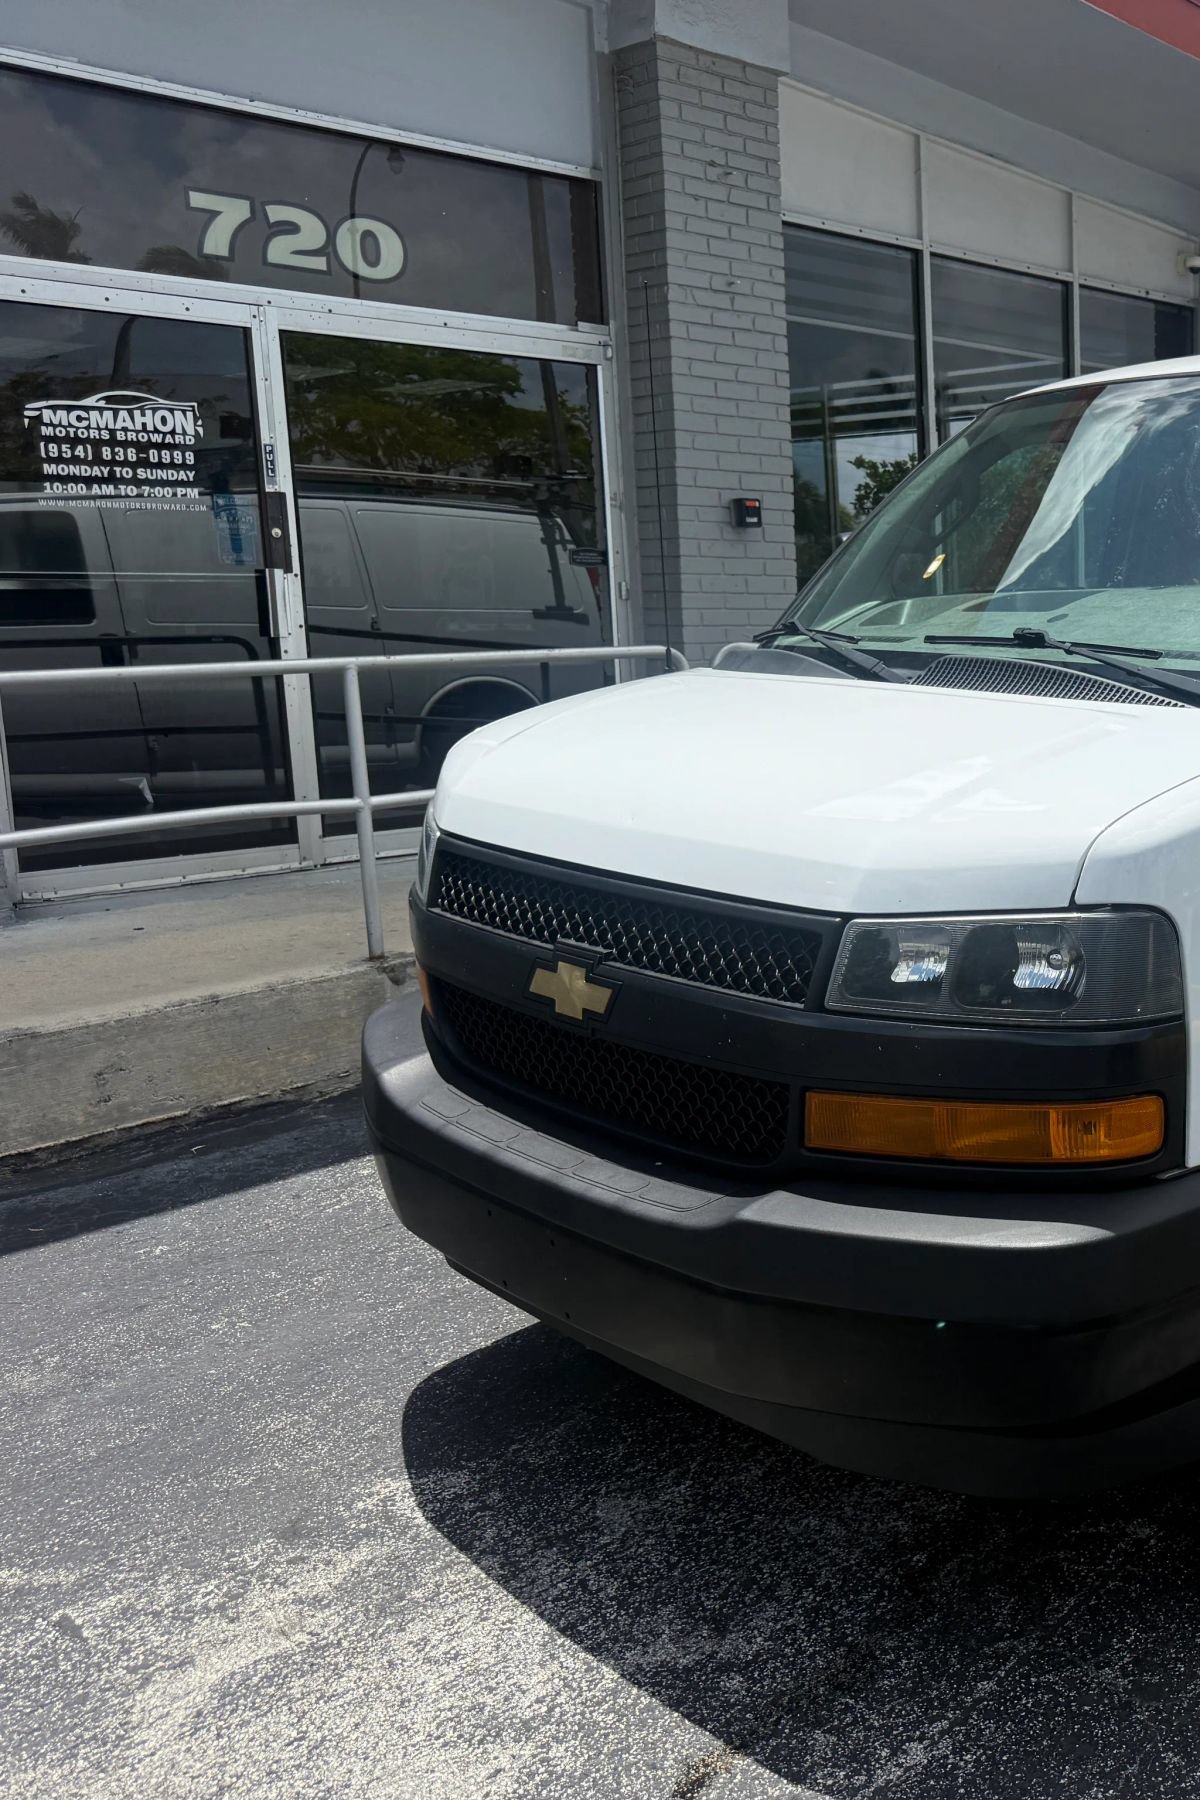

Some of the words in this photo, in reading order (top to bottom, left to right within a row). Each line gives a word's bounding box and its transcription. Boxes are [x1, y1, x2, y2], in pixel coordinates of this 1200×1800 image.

[186, 188, 406, 282] 720
[42, 408, 195, 435] MCMAHON
[41, 426, 110, 440] MOTORS
[116, 430, 195, 445] BROWARD
[40, 441, 92, 461] (954)
[102, 446, 195, 465] 836-0999
[265, 445, 275, 477] PULL
[43, 463, 110, 478] MONDAY
[114, 467, 133, 479] TO
[137, 468, 196, 482] SUNDAY
[43, 482, 87, 495] 10:00
[92, 484, 115, 496] AM
[118, 485, 137, 497] TO
[141, 486, 173, 498] 7:00
[177, 488, 199, 499] PM
